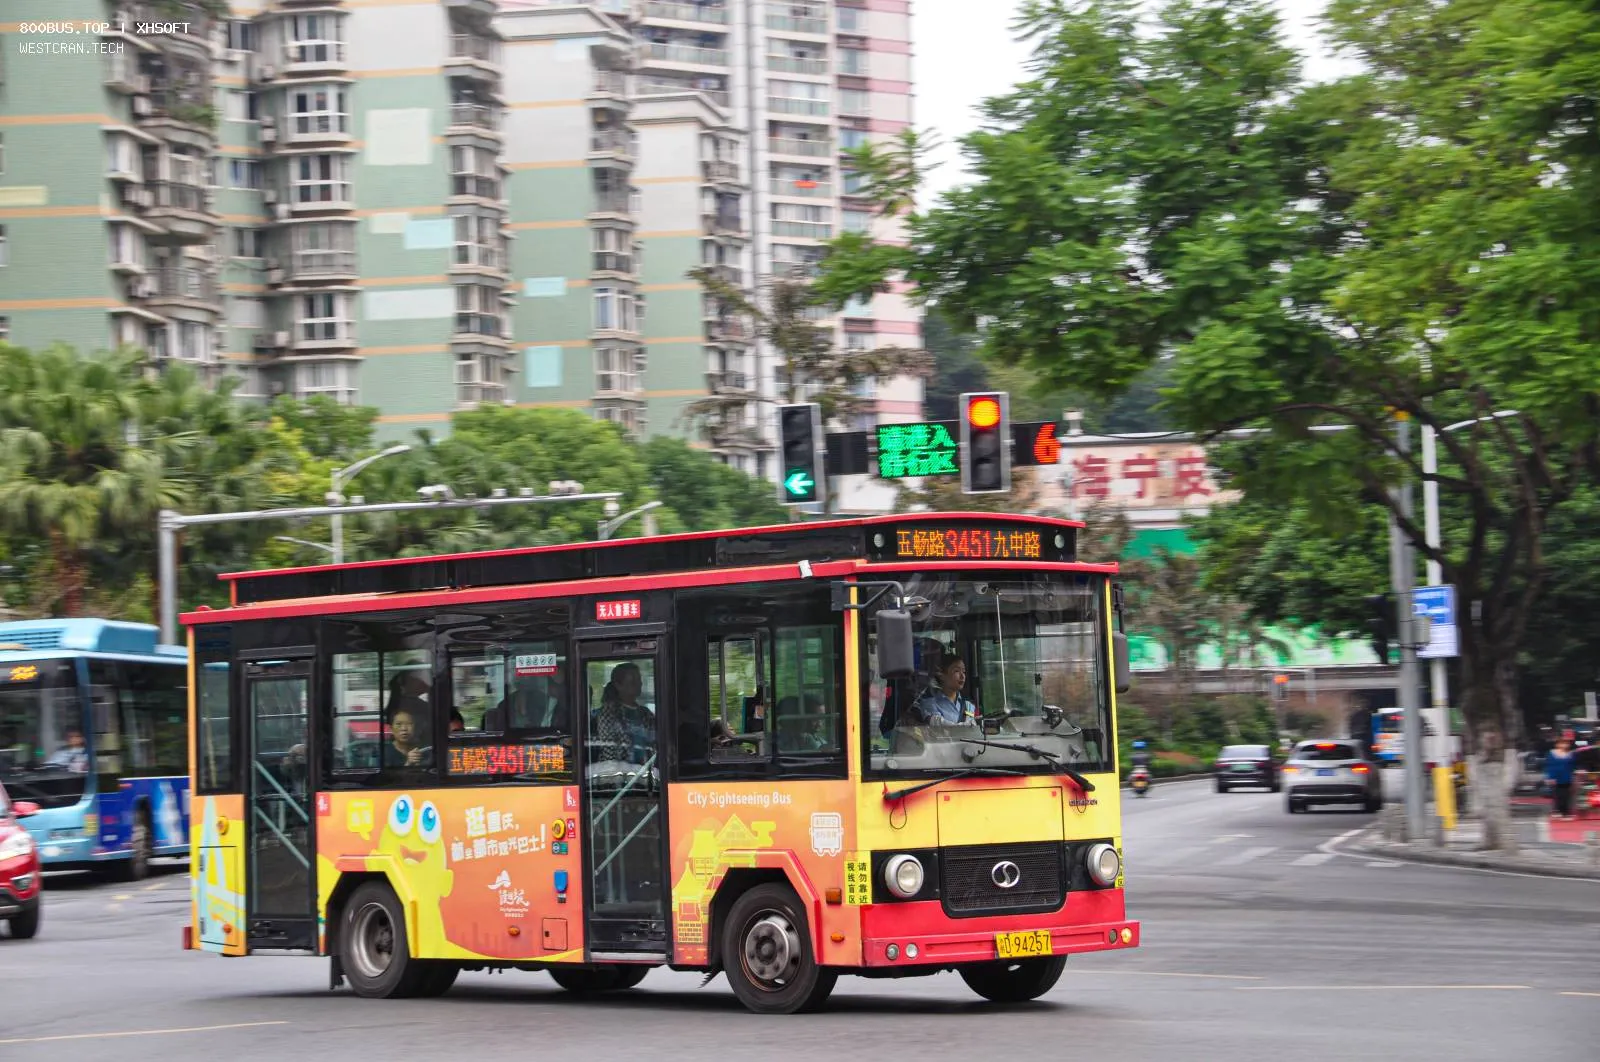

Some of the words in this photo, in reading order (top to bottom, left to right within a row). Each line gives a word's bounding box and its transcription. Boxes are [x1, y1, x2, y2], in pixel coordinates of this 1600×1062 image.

[1033, 422, 1062, 464] 6
[599, 602, 638, 618] 无人售票车
[687, 791, 708, 809] City
[709, 791, 770, 809] Sightseeing
[772, 791, 792, 805] Bus
[847, 862, 856, 904] 视线盲区
[858, 862, 868, 904] 请勿靠近
